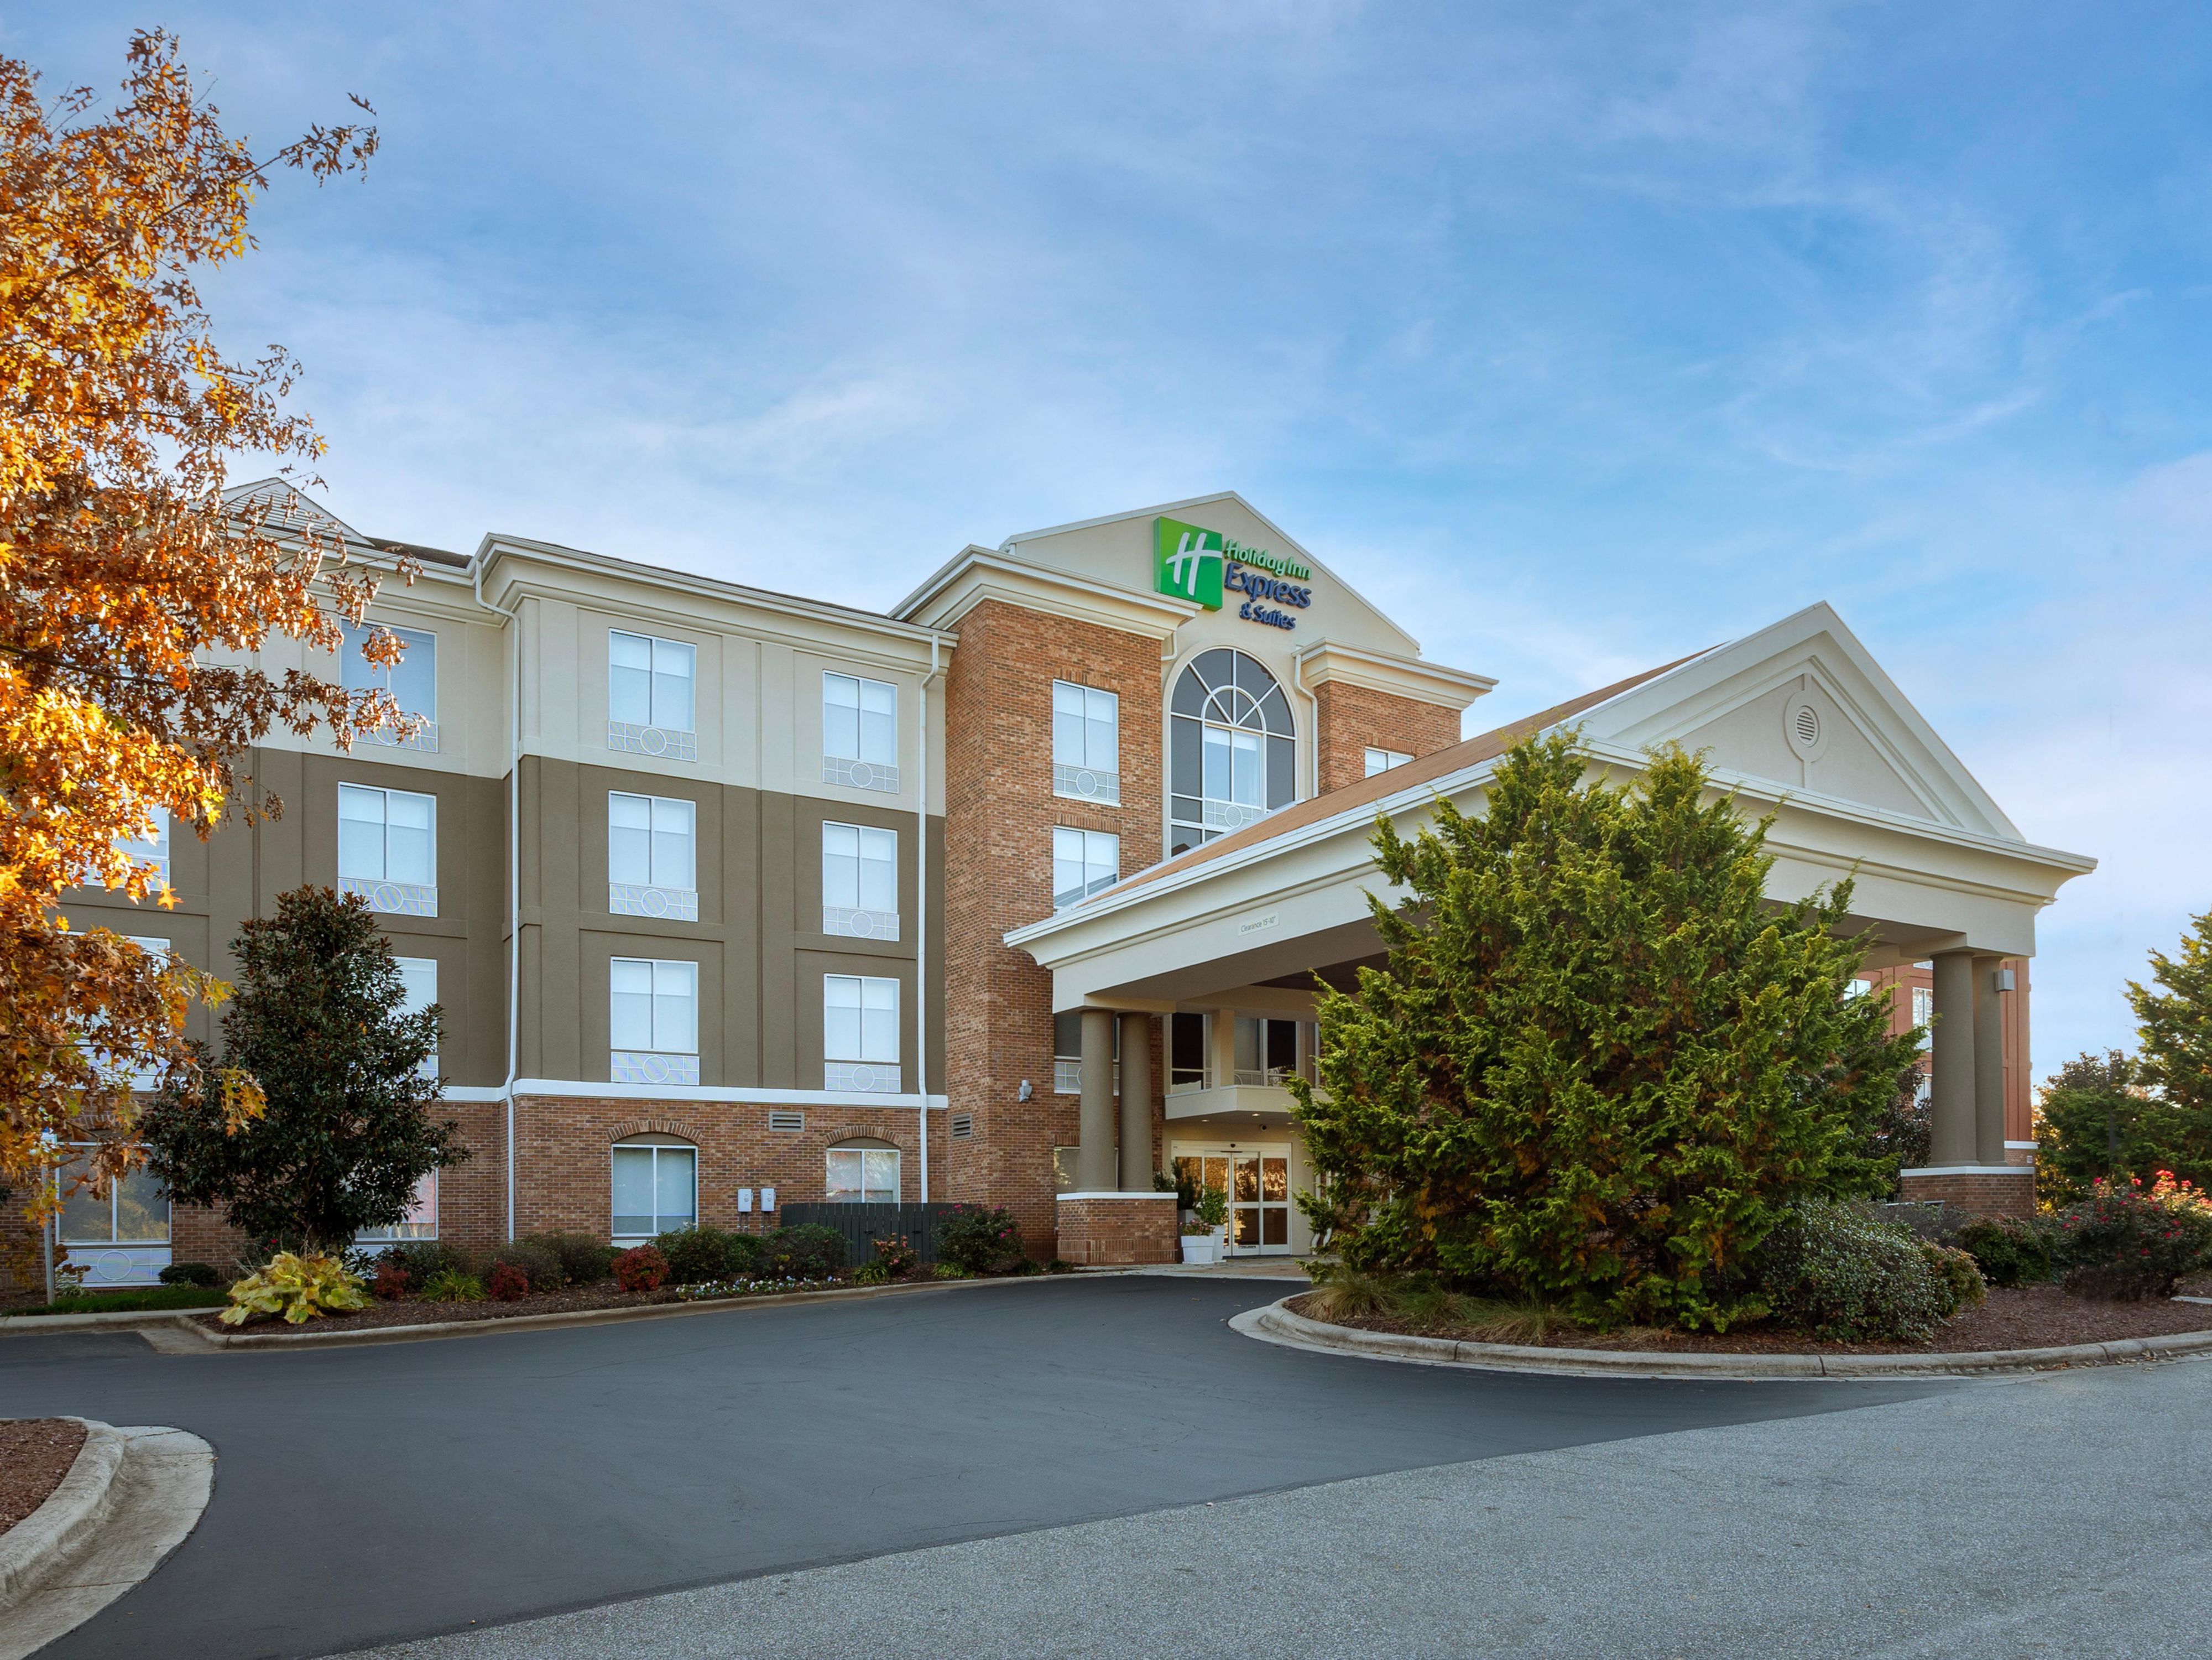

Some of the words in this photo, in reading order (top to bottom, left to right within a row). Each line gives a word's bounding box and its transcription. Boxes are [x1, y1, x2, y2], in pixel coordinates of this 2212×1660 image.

[1166, 532, 1222, 596] H
[1224, 539, 1286, 577] Holiday
[1285, 556, 1312, 581] Inn
[1224, 562, 1312, 608] Express
[1239, 601, 1253, 620] &
[1253, 605, 1296, 631] Suites
[1240, 922, 1262, 933] Clearance
